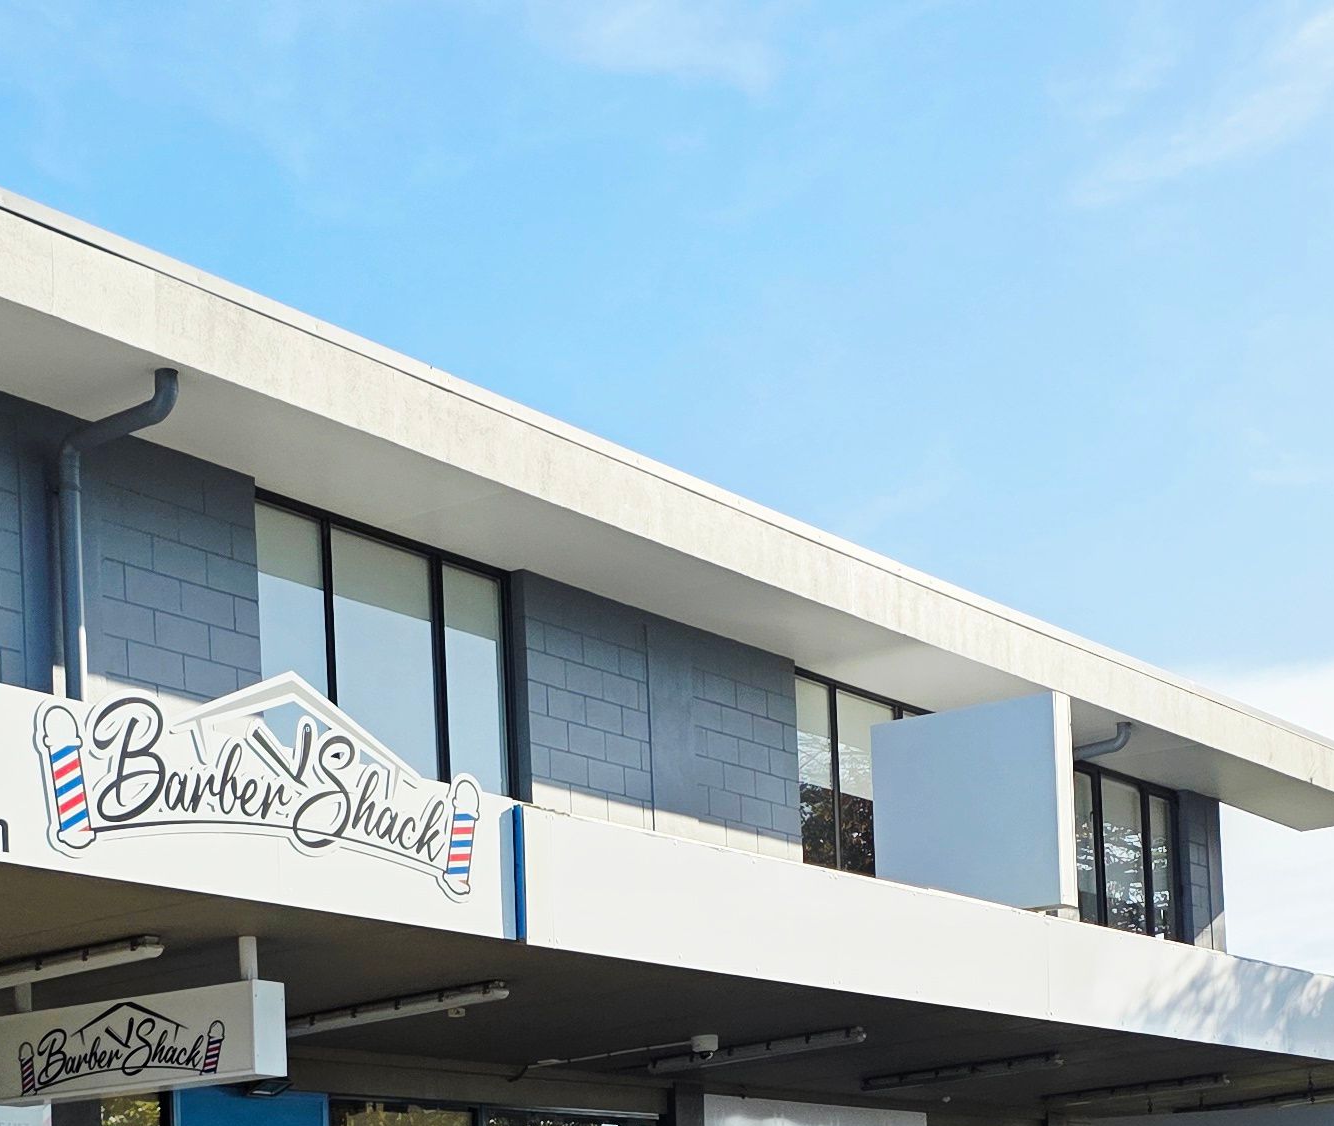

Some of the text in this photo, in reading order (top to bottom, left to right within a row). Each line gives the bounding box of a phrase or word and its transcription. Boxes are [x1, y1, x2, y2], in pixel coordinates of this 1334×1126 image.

[92, 697, 446, 862] Barber Shack
[38, 1017, 204, 1086] Barber Shack
